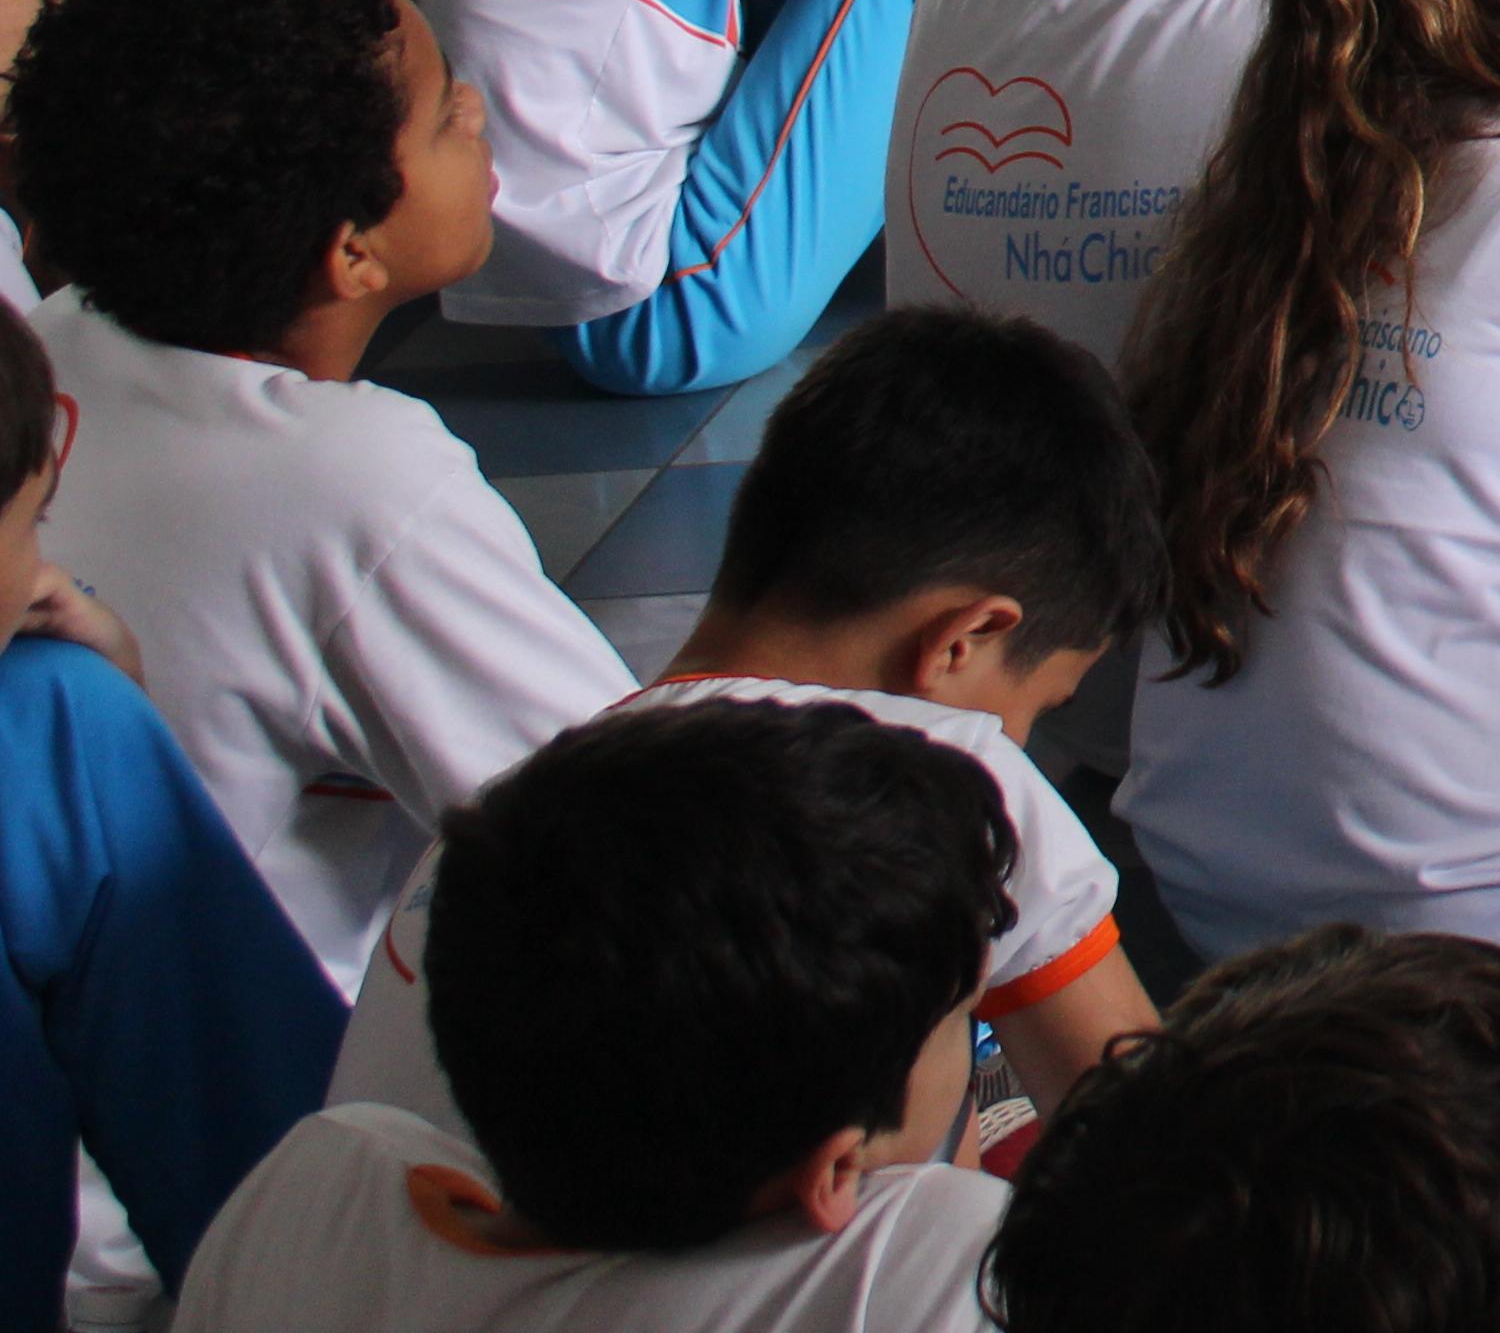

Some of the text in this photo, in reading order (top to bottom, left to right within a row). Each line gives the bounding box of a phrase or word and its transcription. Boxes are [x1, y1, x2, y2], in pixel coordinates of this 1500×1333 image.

[942, 176, 1182, 220] Educandário Francisca
[1005, 229, 1161, 283] Nhá Chic
